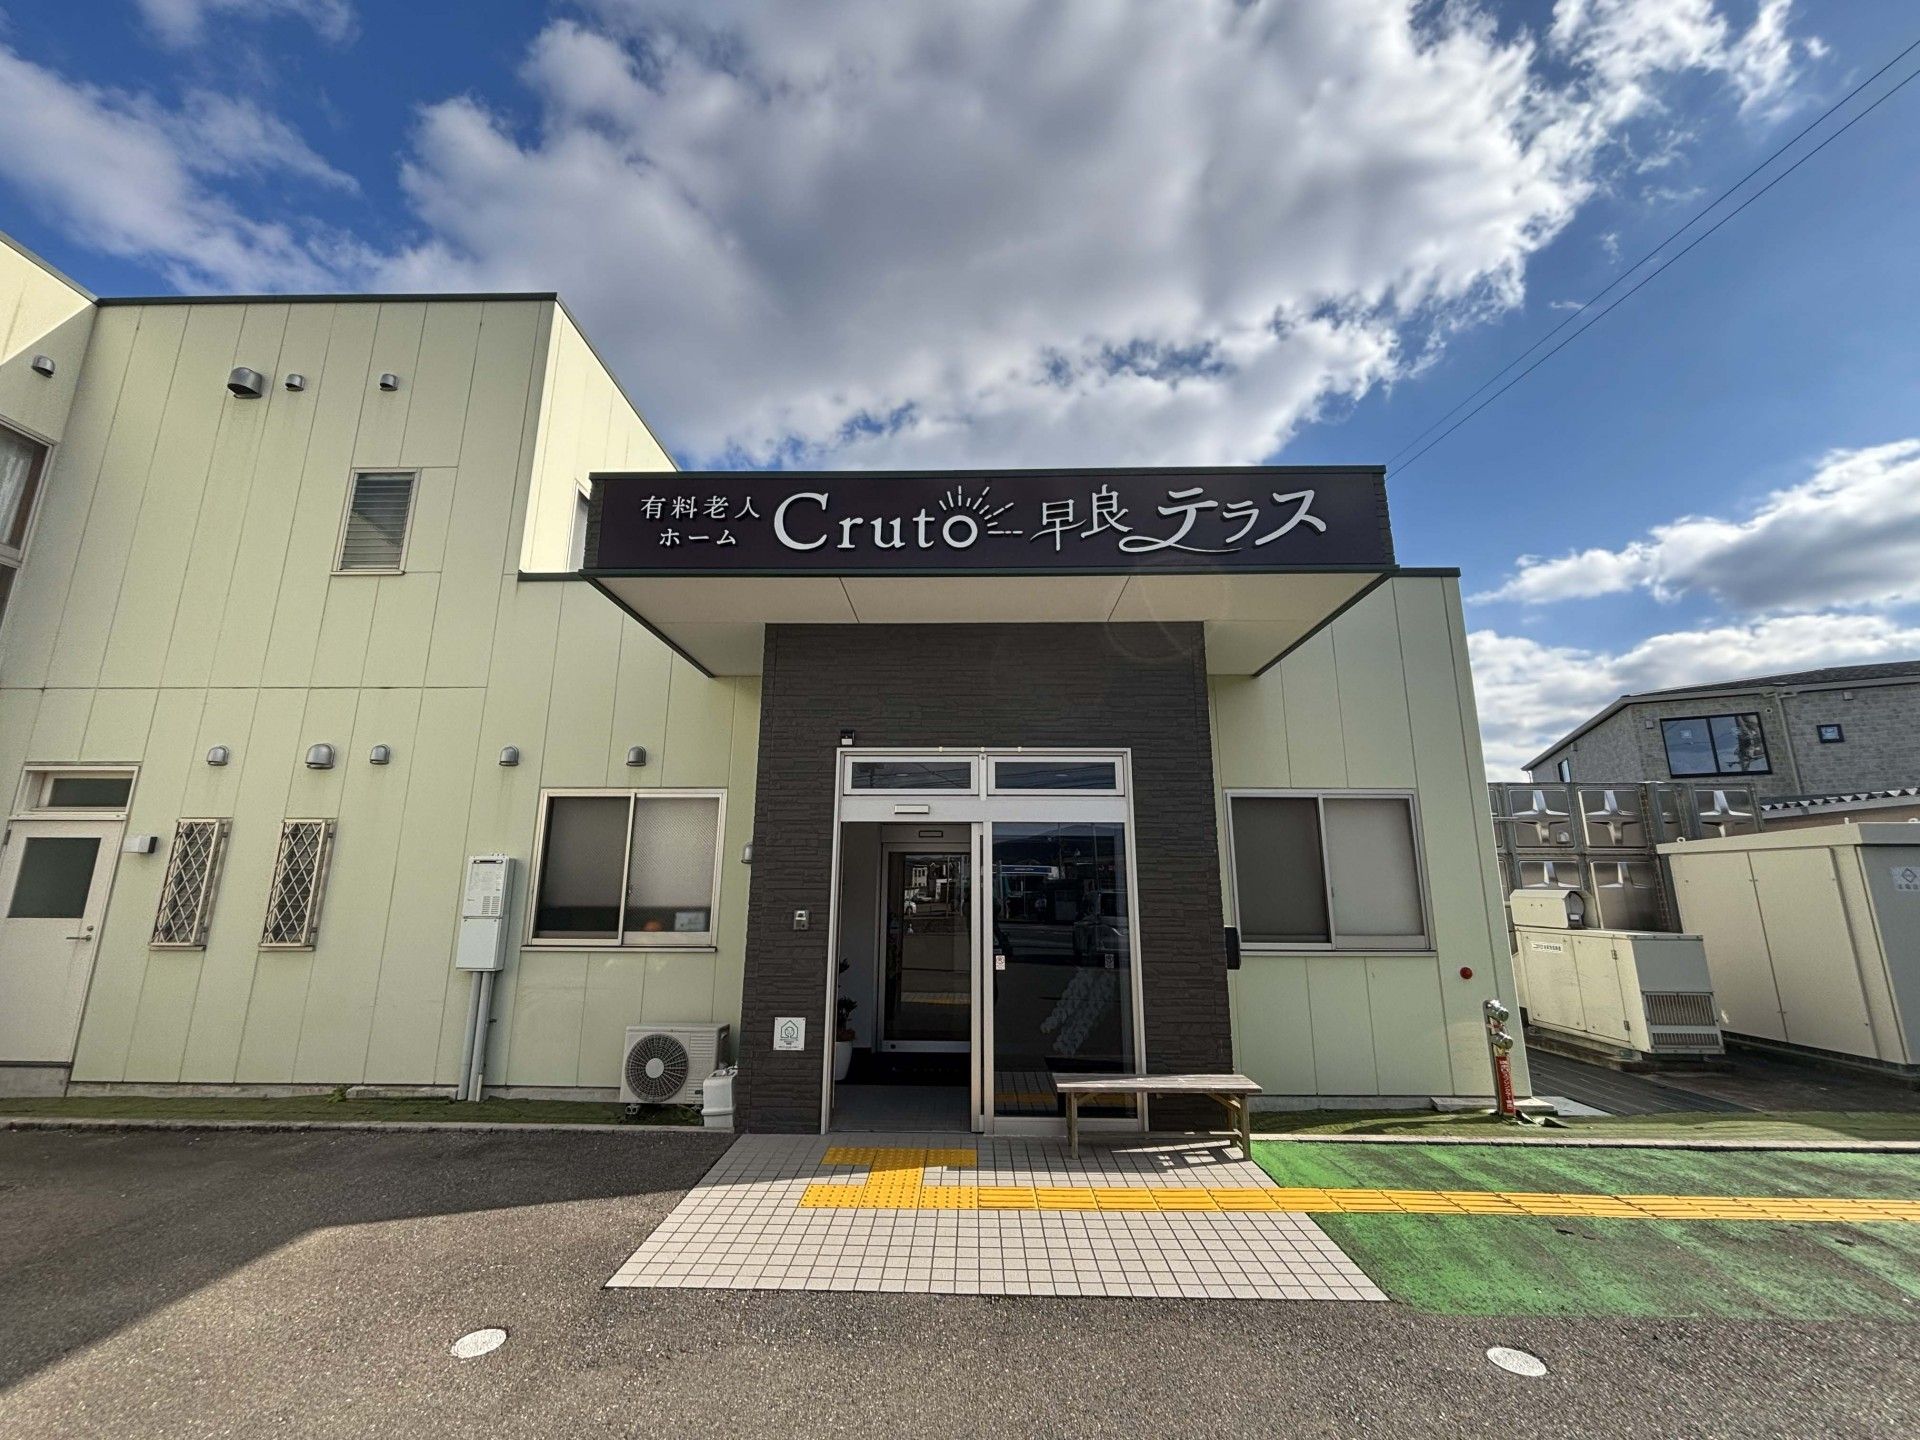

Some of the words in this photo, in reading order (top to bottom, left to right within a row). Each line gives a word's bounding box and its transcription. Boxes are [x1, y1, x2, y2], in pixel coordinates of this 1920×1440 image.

[640, 495, 760, 520] 有料老人
[773, 492, 978, 550] Cruto
[659, 527, 737, 547] ホーム
